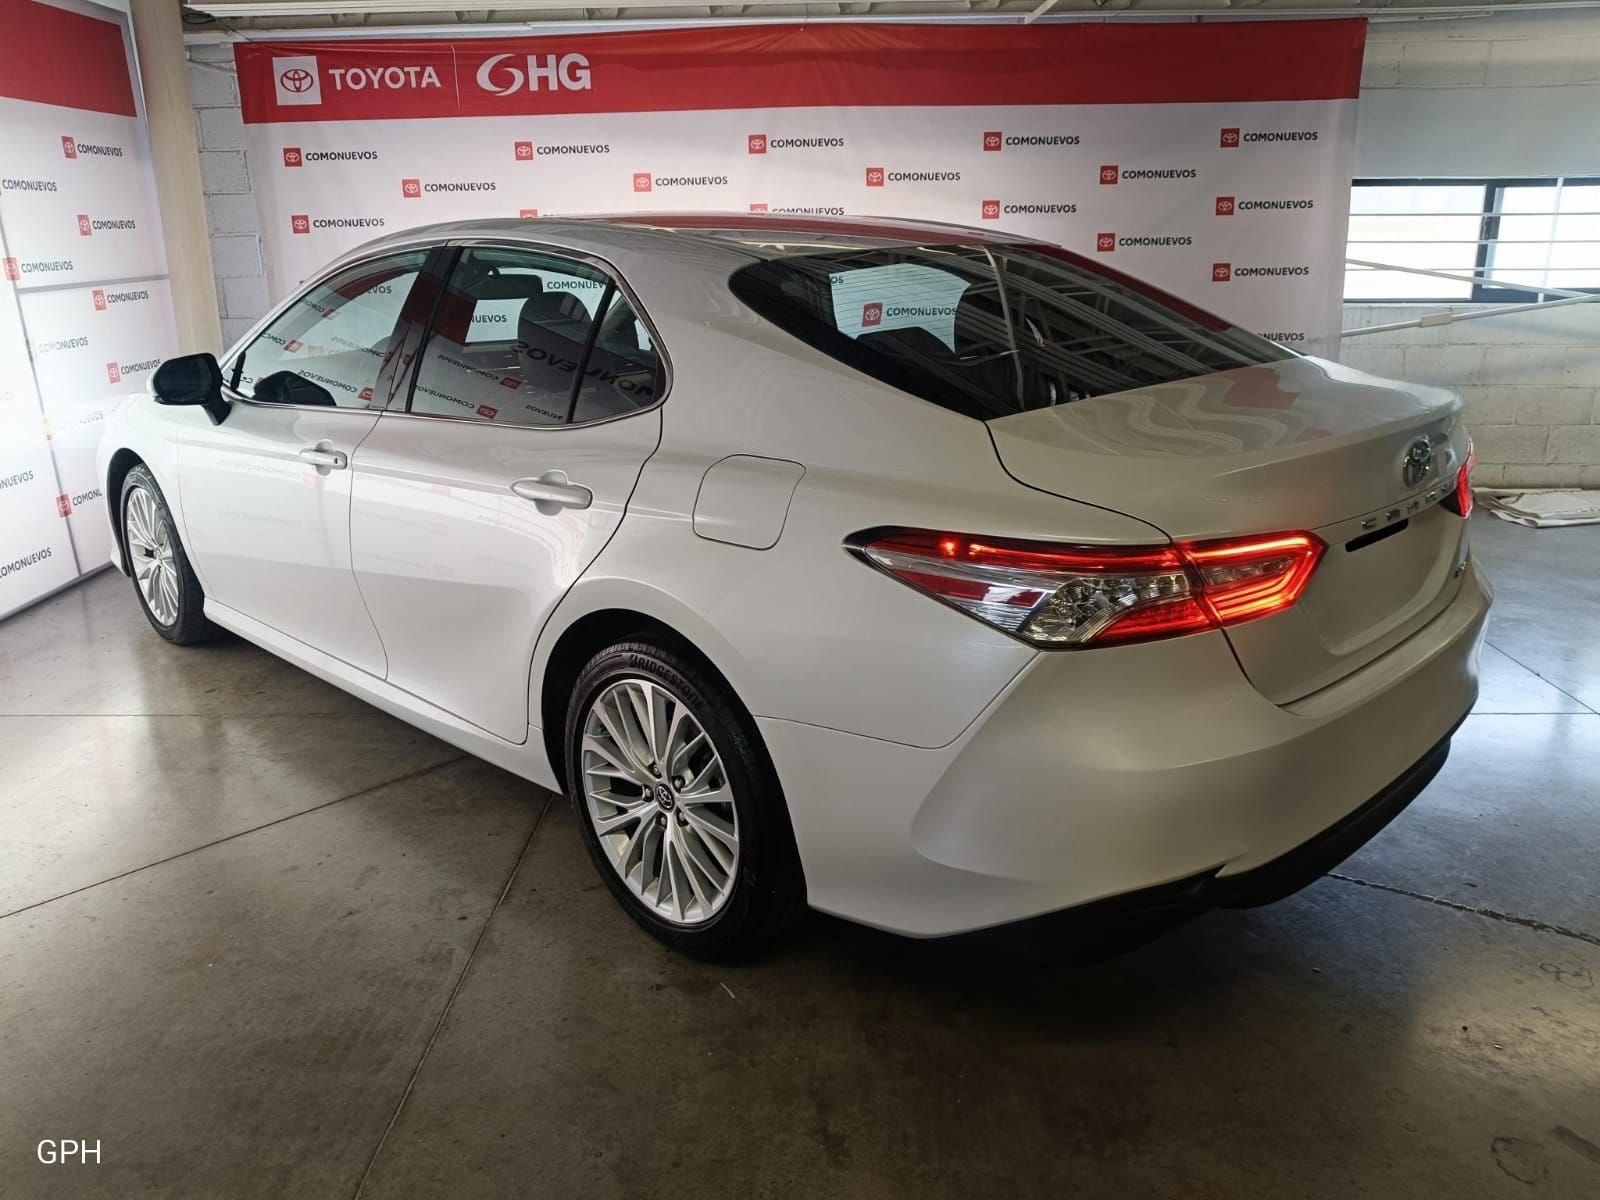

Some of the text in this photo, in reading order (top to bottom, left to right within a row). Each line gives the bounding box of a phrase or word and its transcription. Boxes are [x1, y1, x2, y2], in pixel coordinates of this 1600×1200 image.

[328, 66, 441, 91] TOYOTA
[770, 136, 845, 149] COMONUEVOS
[1005, 135, 1080, 146] COMONUEVOS
[1243, 131, 1319, 143] COMONUEVOS
[77, 143, 123, 157] COMONUEVOS
[537, 144, 610, 155] COMONUEVOS
[305, 150, 378, 162] COMONUEVOS
[887, 171, 961, 182] COMONUEVOS
[1122, 168, 1197, 180] COMONUEVOS
[2, 179, 58, 192] COMONUEVOS
[424, 181, 496, 193] COMONUEVOS
[655, 176, 728, 187] COMONUEVOS
[772, 206, 845, 216] COMONUEVOS
[1003, 203, 1077, 214] COMONUEVOS
[1238, 199, 1314, 211] COMONUEVOS
[92, 220, 136, 230] COMONUEVOS
[312, 217, 385, 229] COMONUEVOS
[1118, 236, 1192, 248] COMONUEVOS
[21, 260, 74, 274] COMONUEVOS
[1234, 266, 1310, 278] COMONUEVOS
[106, 291, 149, 304] COMONUEVOS
[629, 653, 706, 710] BRIDGESTONE
